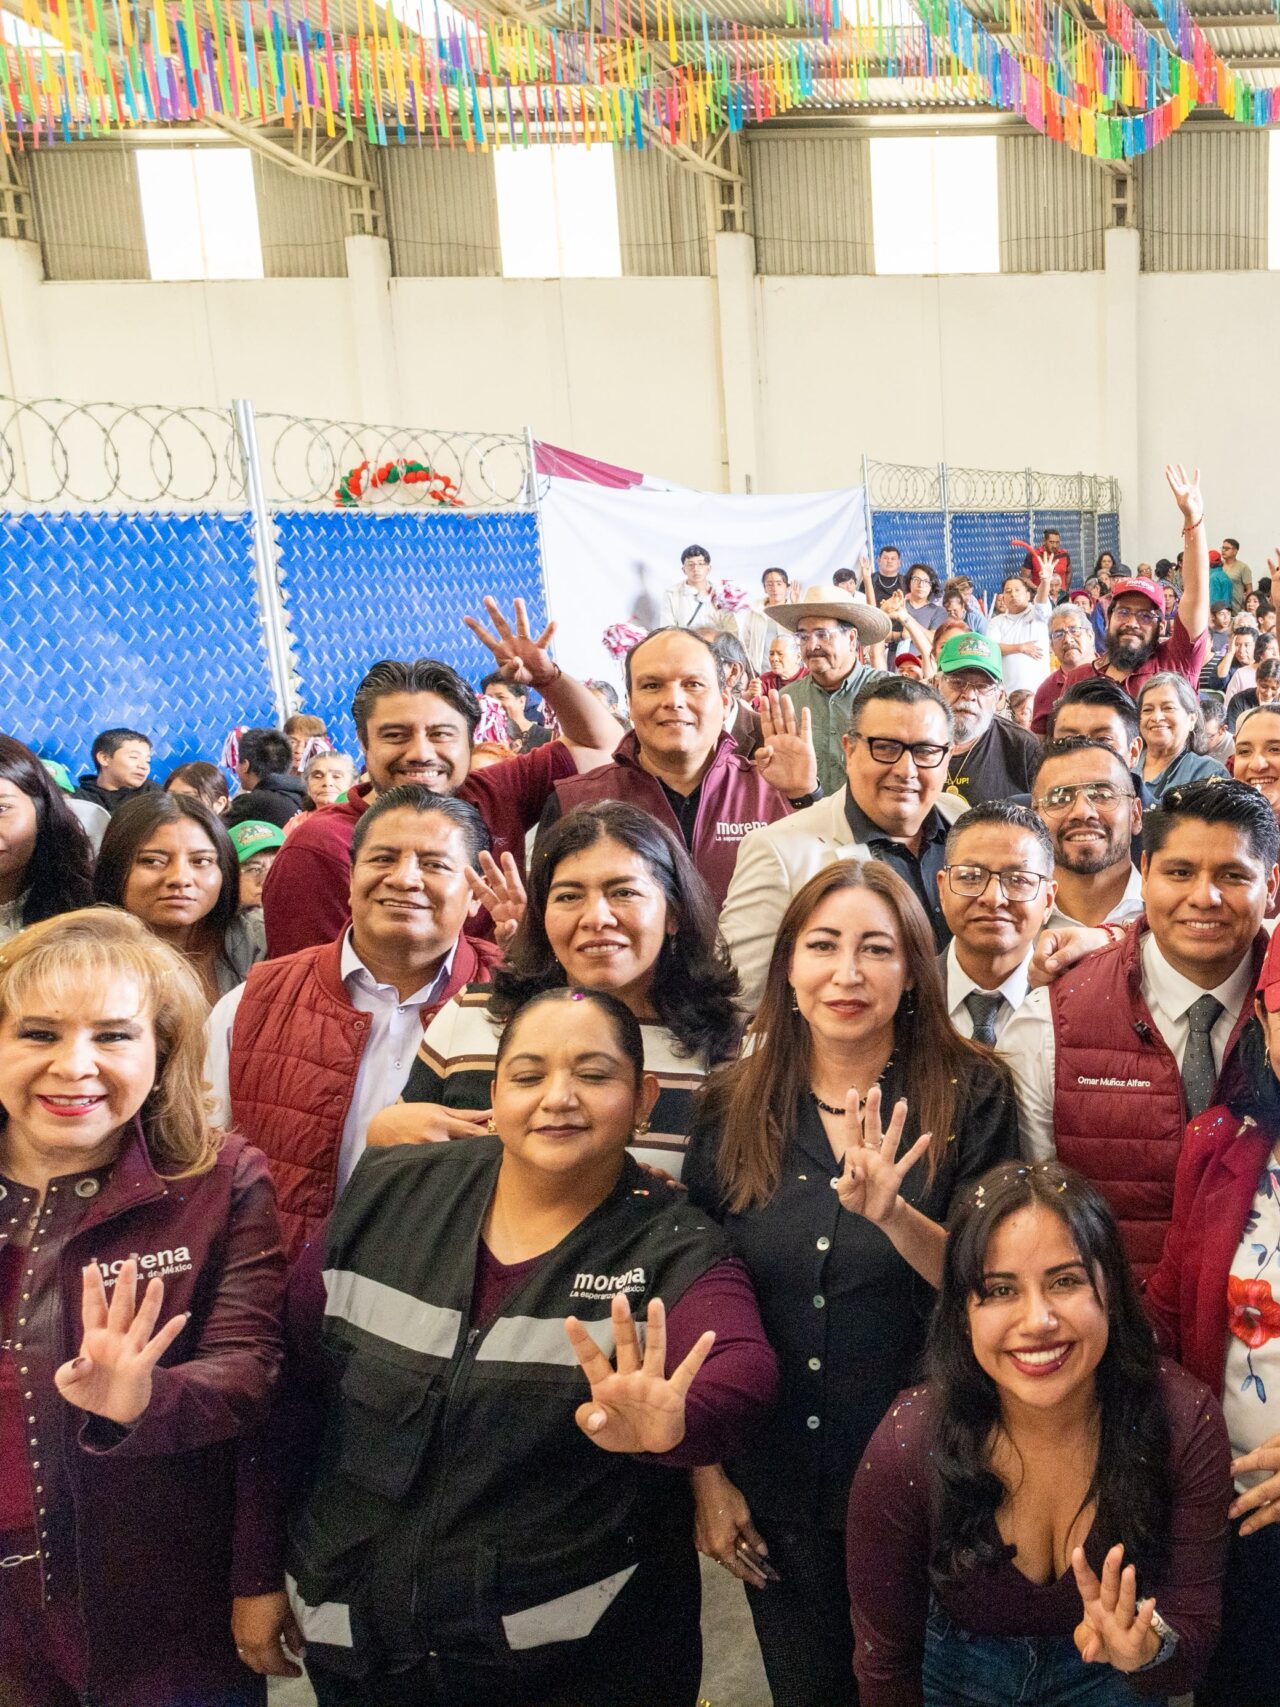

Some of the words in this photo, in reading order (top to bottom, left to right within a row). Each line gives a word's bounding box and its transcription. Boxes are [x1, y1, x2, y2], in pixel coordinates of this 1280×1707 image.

[956, 777, 969, 785] UP!
[1077, 1076, 1099, 1085] Omar
[1100, 1077, 1125, 1087] Muñoz
[1126, 1079, 1151, 1087] Alfaro
[82, 1246, 191, 1278] oena
[160, 1263, 193, 1275] México
[573, 1267, 646, 1291] morena
